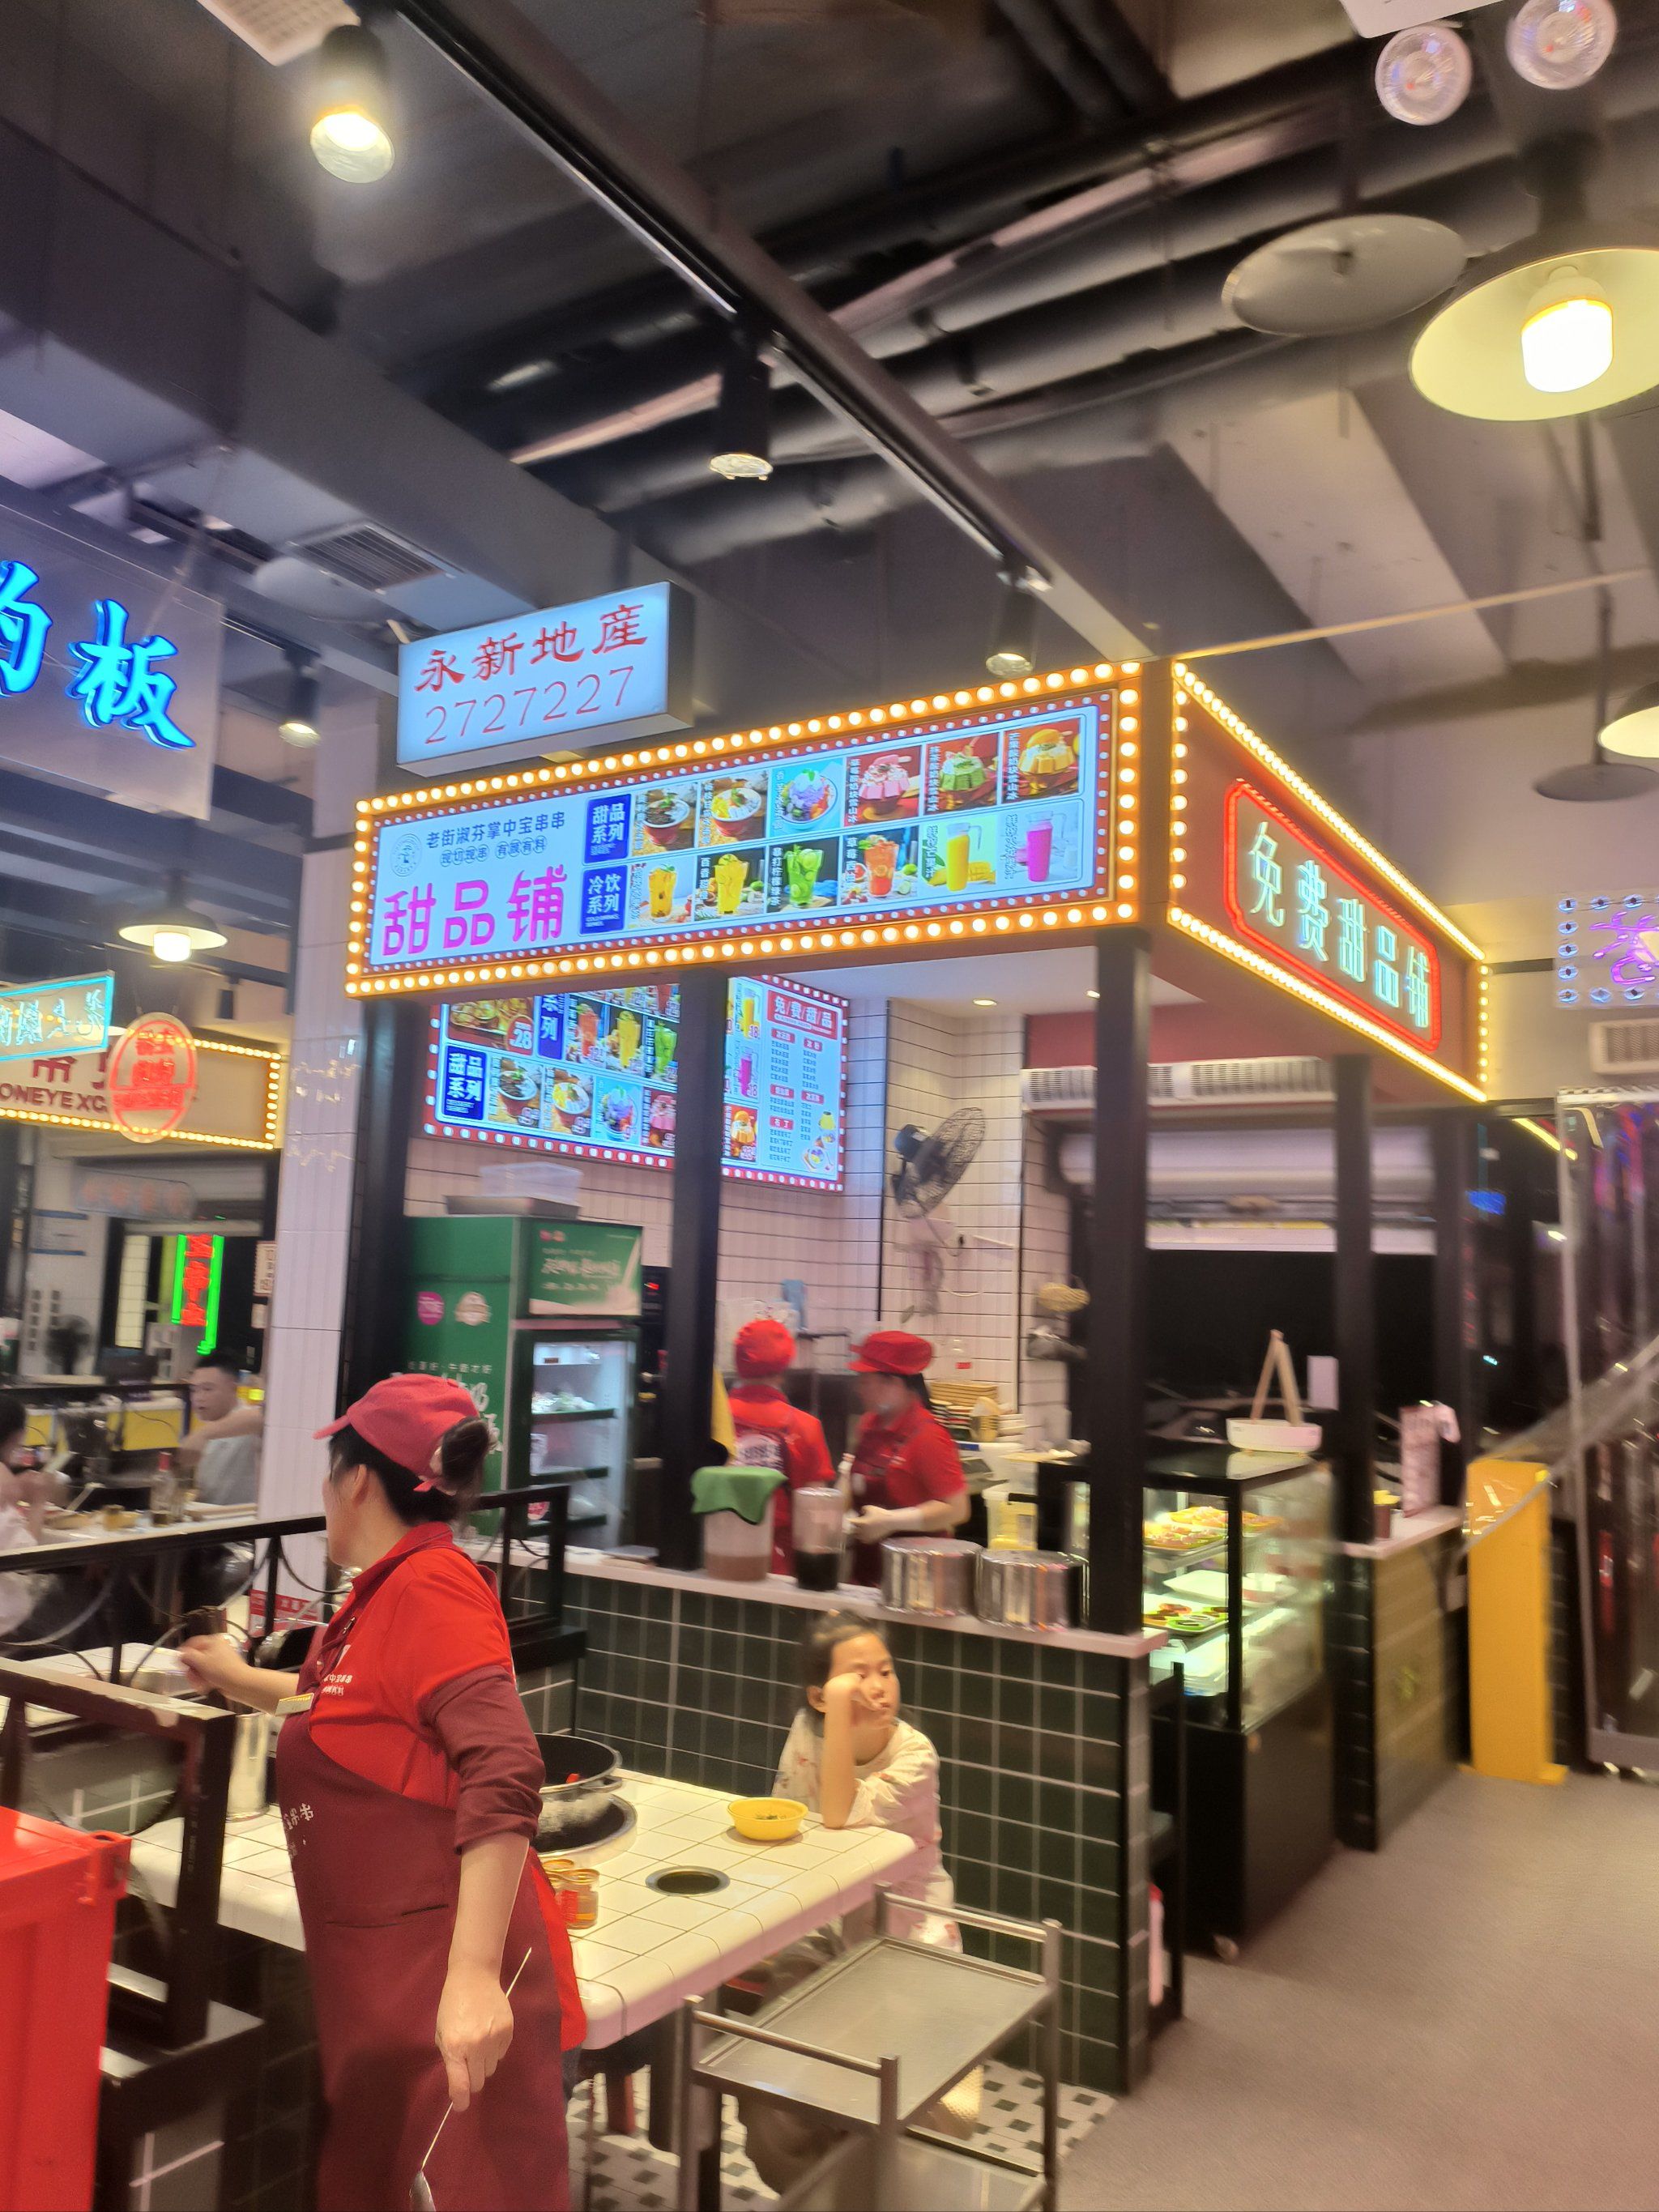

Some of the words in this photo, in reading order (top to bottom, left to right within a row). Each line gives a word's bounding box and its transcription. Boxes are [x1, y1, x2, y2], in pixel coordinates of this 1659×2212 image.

[414, 604, 648, 692] 永新地産
[424, 665, 634, 744] 2727227
[592, 803, 625, 825] 甜品
[426, 811, 565, 849] 老街淑芬掌中宝串串
[591, 823, 624, 844] 系列
[589, 873, 621, 894] 冷饮
[382, 864, 567, 956] 甜品铺
[586, 893, 619, 914] 系列
[1248, 821, 1429, 1028] 免费甜品铺
[448, 1052, 484, 1078] 甜品
[448, 1077, 482, 1102] 系列
